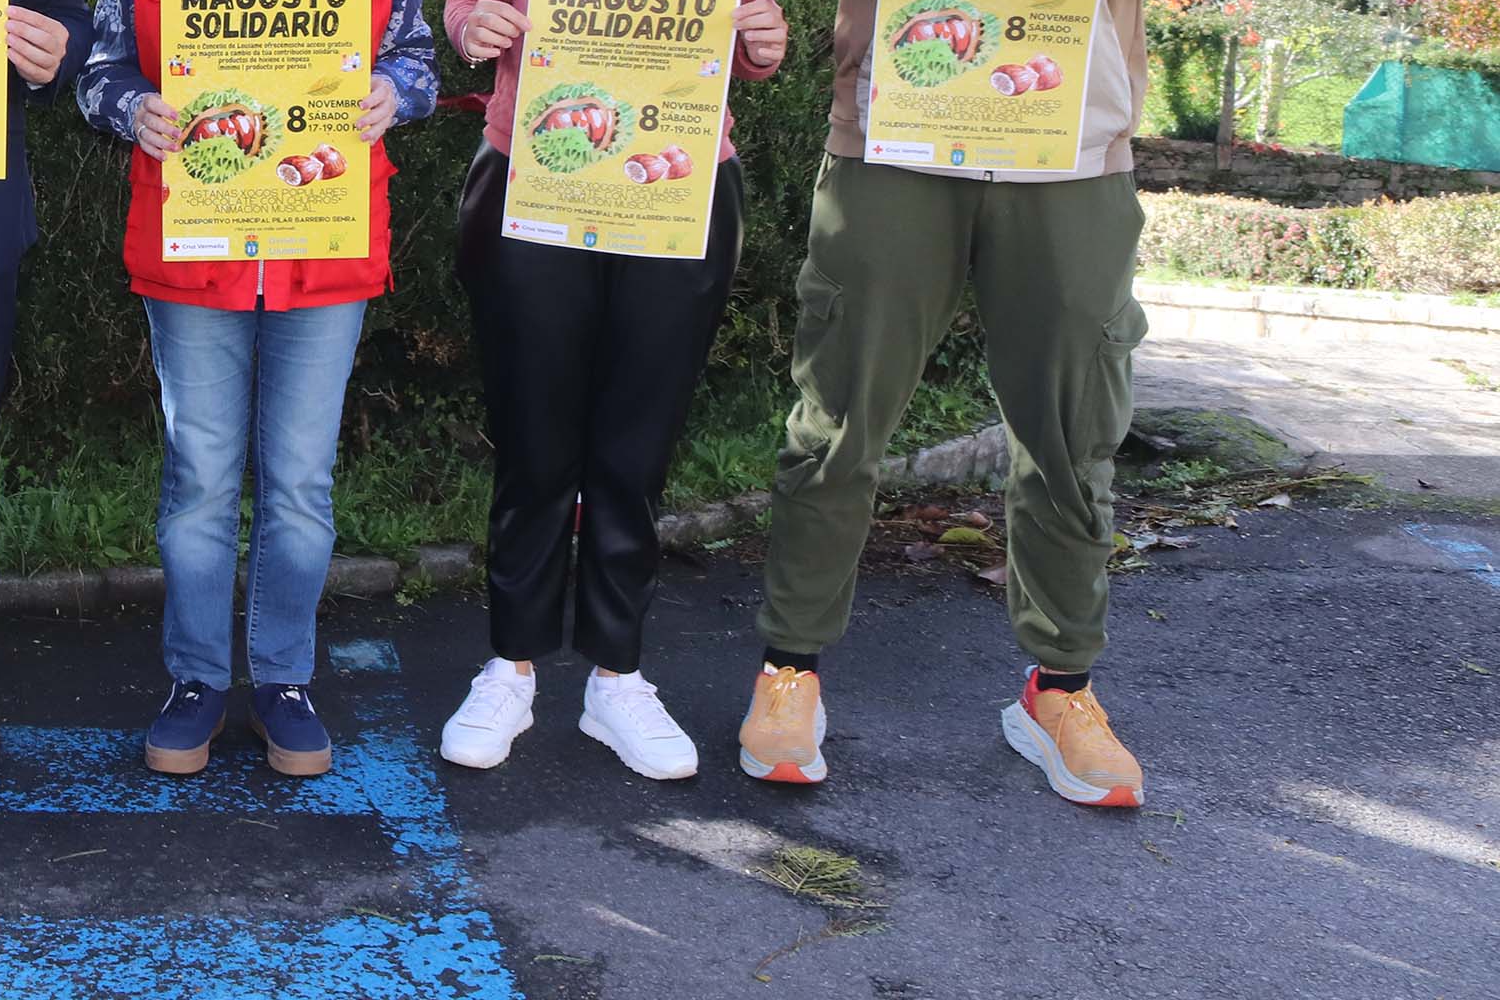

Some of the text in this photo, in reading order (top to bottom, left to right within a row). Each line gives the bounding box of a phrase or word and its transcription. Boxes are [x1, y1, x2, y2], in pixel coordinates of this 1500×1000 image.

[185, 10, 339, 39] SOLIDARIO
[549, 8, 704, 43] SOLIDARIO
[1029, 12, 1091, 23] NOVEMBRO
[1004, 15, 1026, 41] 8
[1026, 34, 1071, 45] 17-19.00
[662, 101, 720, 113] NOVEMBRO
[286, 105, 307, 132] 8
[639, 104, 660, 131] 8
[308, 123, 350, 132] 17-19.00
[659, 124, 701, 135] 17-19.00
